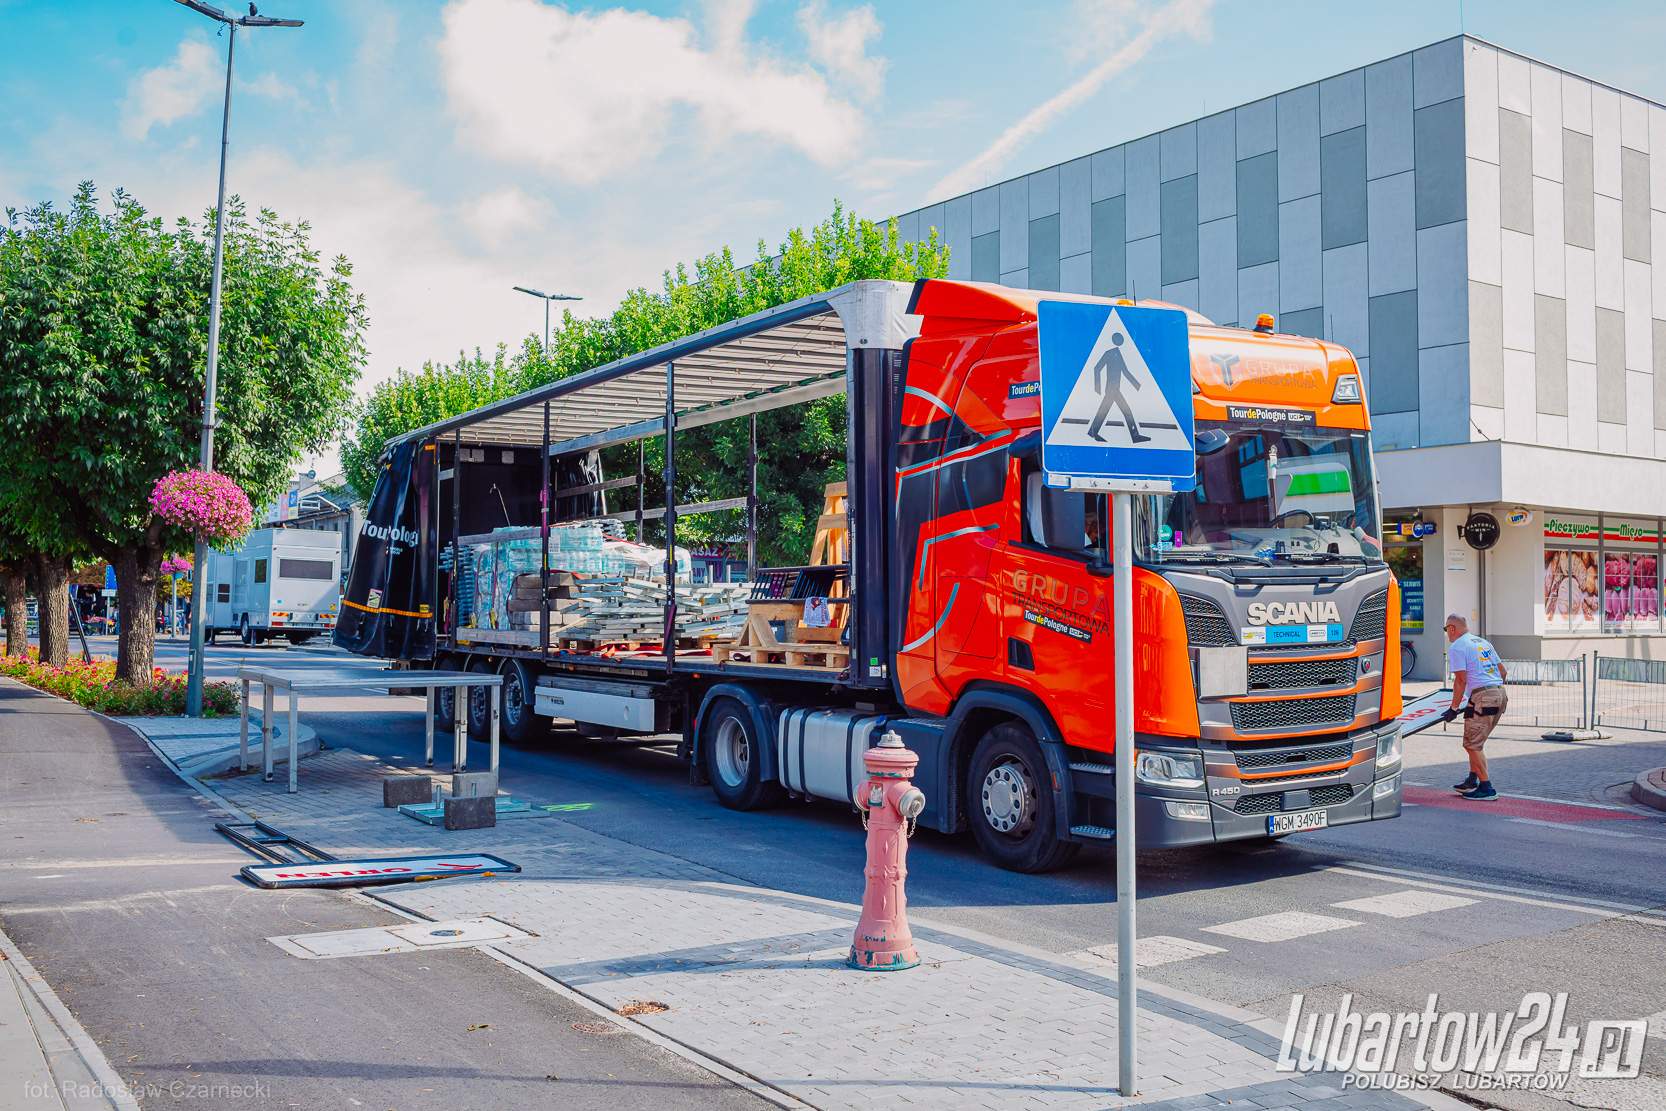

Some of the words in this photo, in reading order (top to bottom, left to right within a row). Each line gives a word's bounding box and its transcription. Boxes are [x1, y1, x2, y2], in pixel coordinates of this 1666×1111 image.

[1011, 382, 1040, 395] TourdeP
[1230, 407, 1286, 423] TourdePologne
[1549, 519, 1590, 538] Pieczywo
[1619, 524, 1643, 541] Mięso
[1013, 569, 1111, 622] GRUPA
[1025, 609, 1068, 632] TourdePologne
[1247, 600, 1341, 626] SCANIA
[1273, 631, 1301, 639] TECHNICAL
[1212, 788, 1220, 796] R
[1220, 787, 1240, 796] 450
[1297, 811, 1326, 828] 3490F
